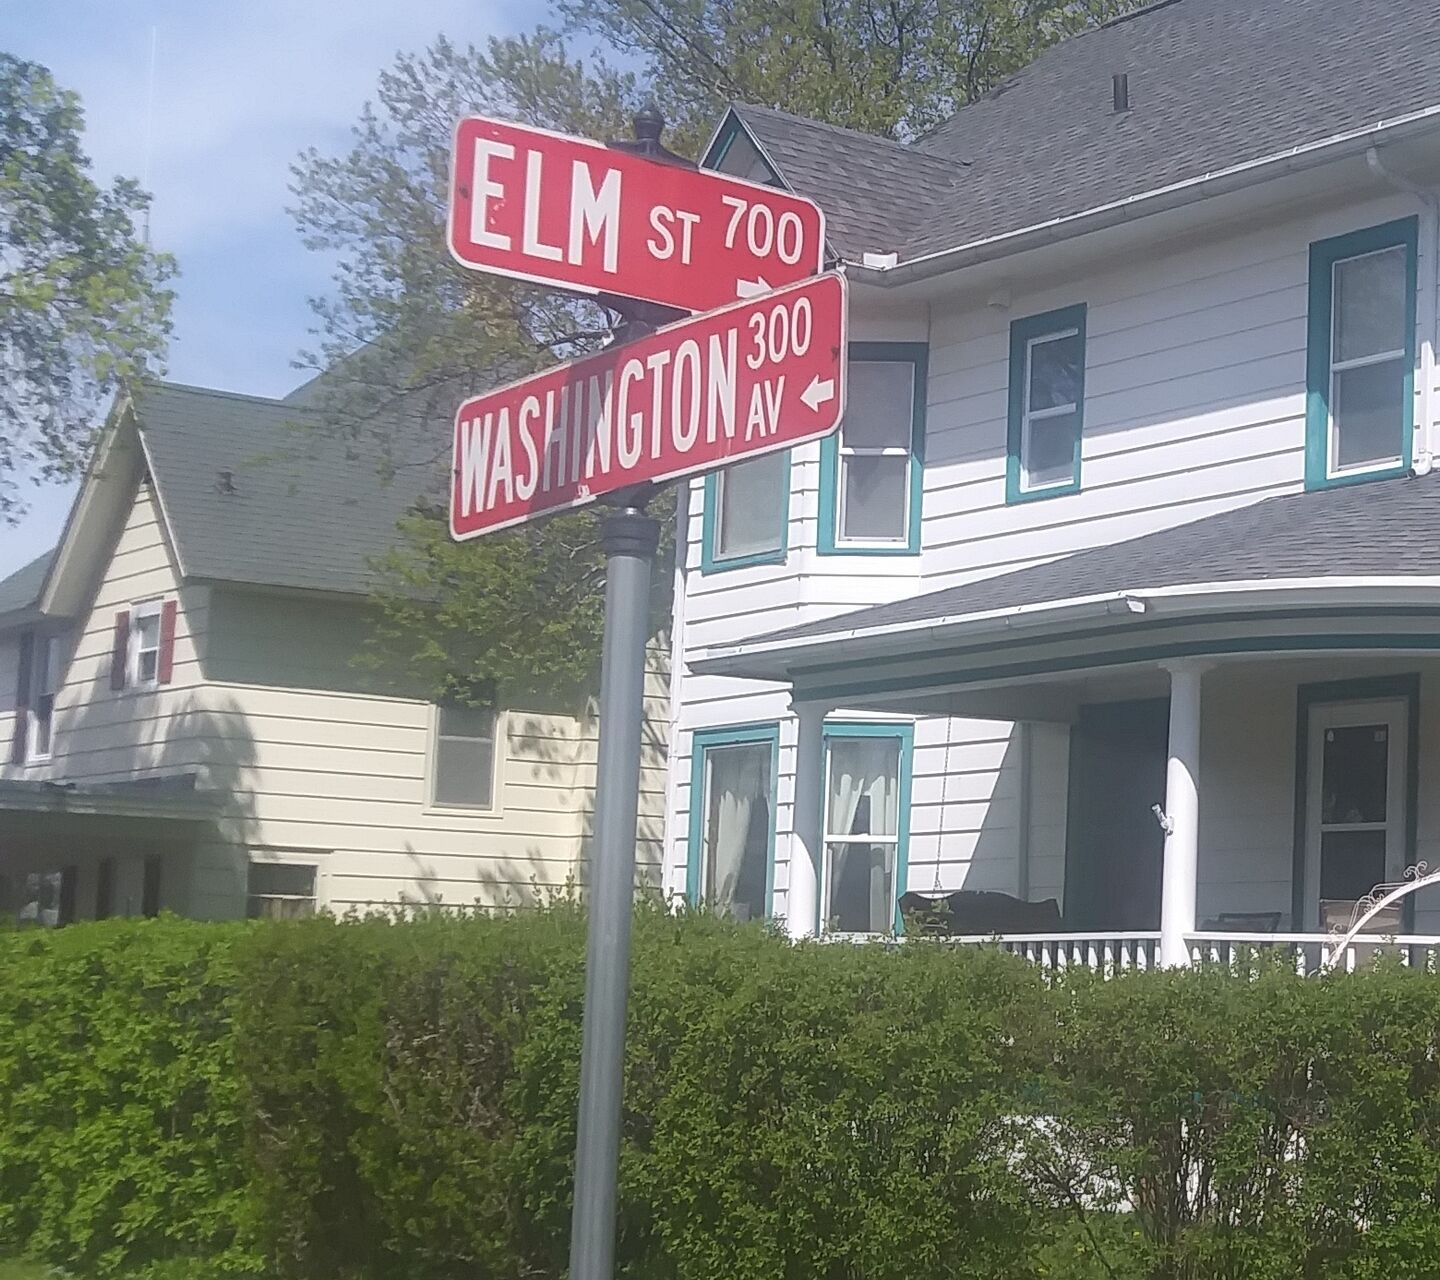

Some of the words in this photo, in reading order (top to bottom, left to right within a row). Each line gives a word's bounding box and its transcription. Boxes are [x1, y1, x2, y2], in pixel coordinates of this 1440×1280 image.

[470, 136, 622, 273] ELM
[646, 205, 700, 265] ST
[721, 194, 804, 266] 700
[746, 296, 812, 370] 300
[461, 327, 738, 518] WASHINGTON
[745, 375, 786, 442] AV
